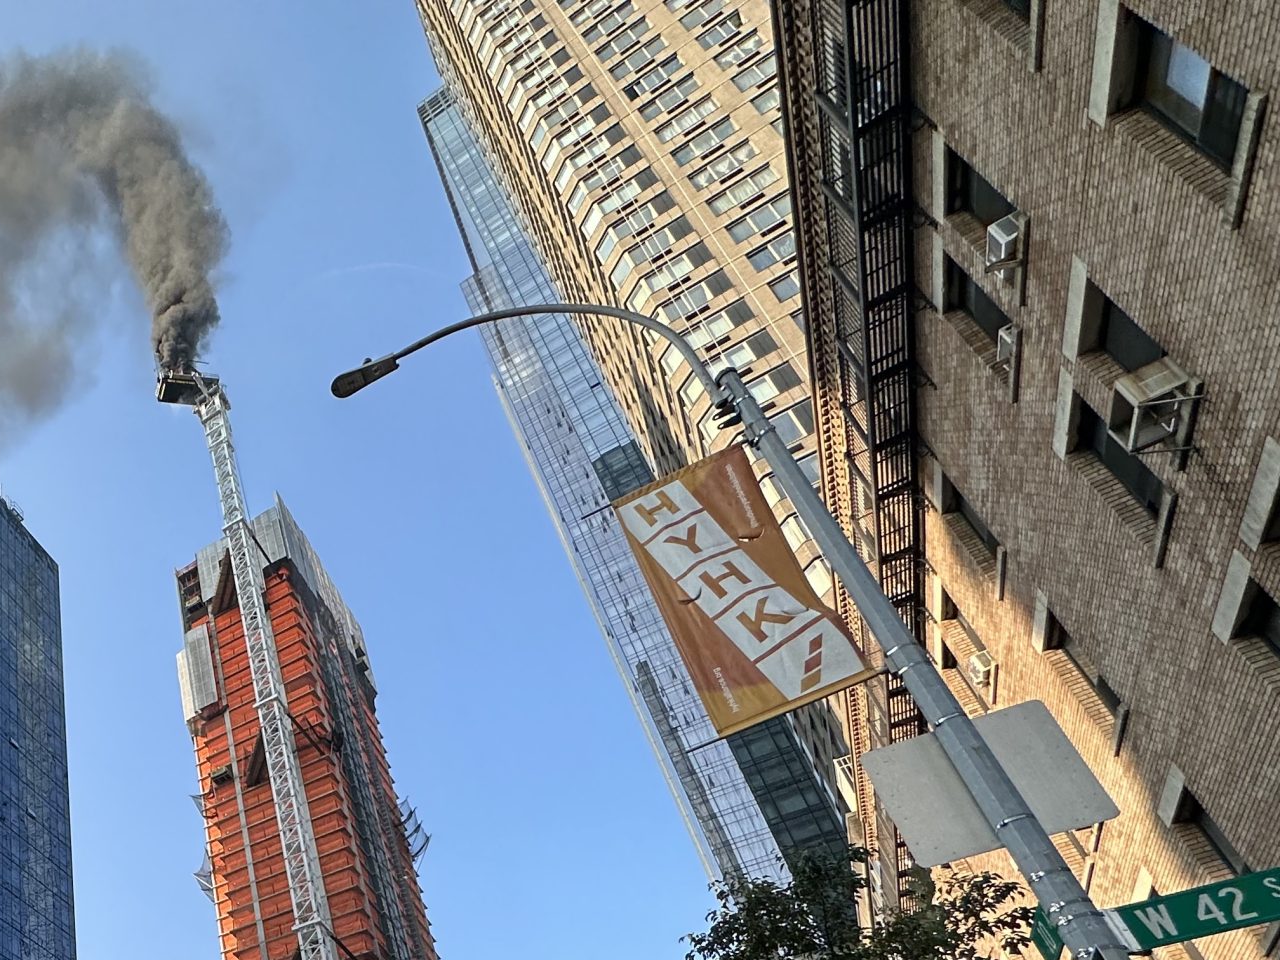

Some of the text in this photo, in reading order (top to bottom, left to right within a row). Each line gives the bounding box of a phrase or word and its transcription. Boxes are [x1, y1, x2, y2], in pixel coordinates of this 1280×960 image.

[634, 489, 798, 643] HYHK
[1134, 904, 1179, 940] W
[1196, 887, 1258, 925] 42
